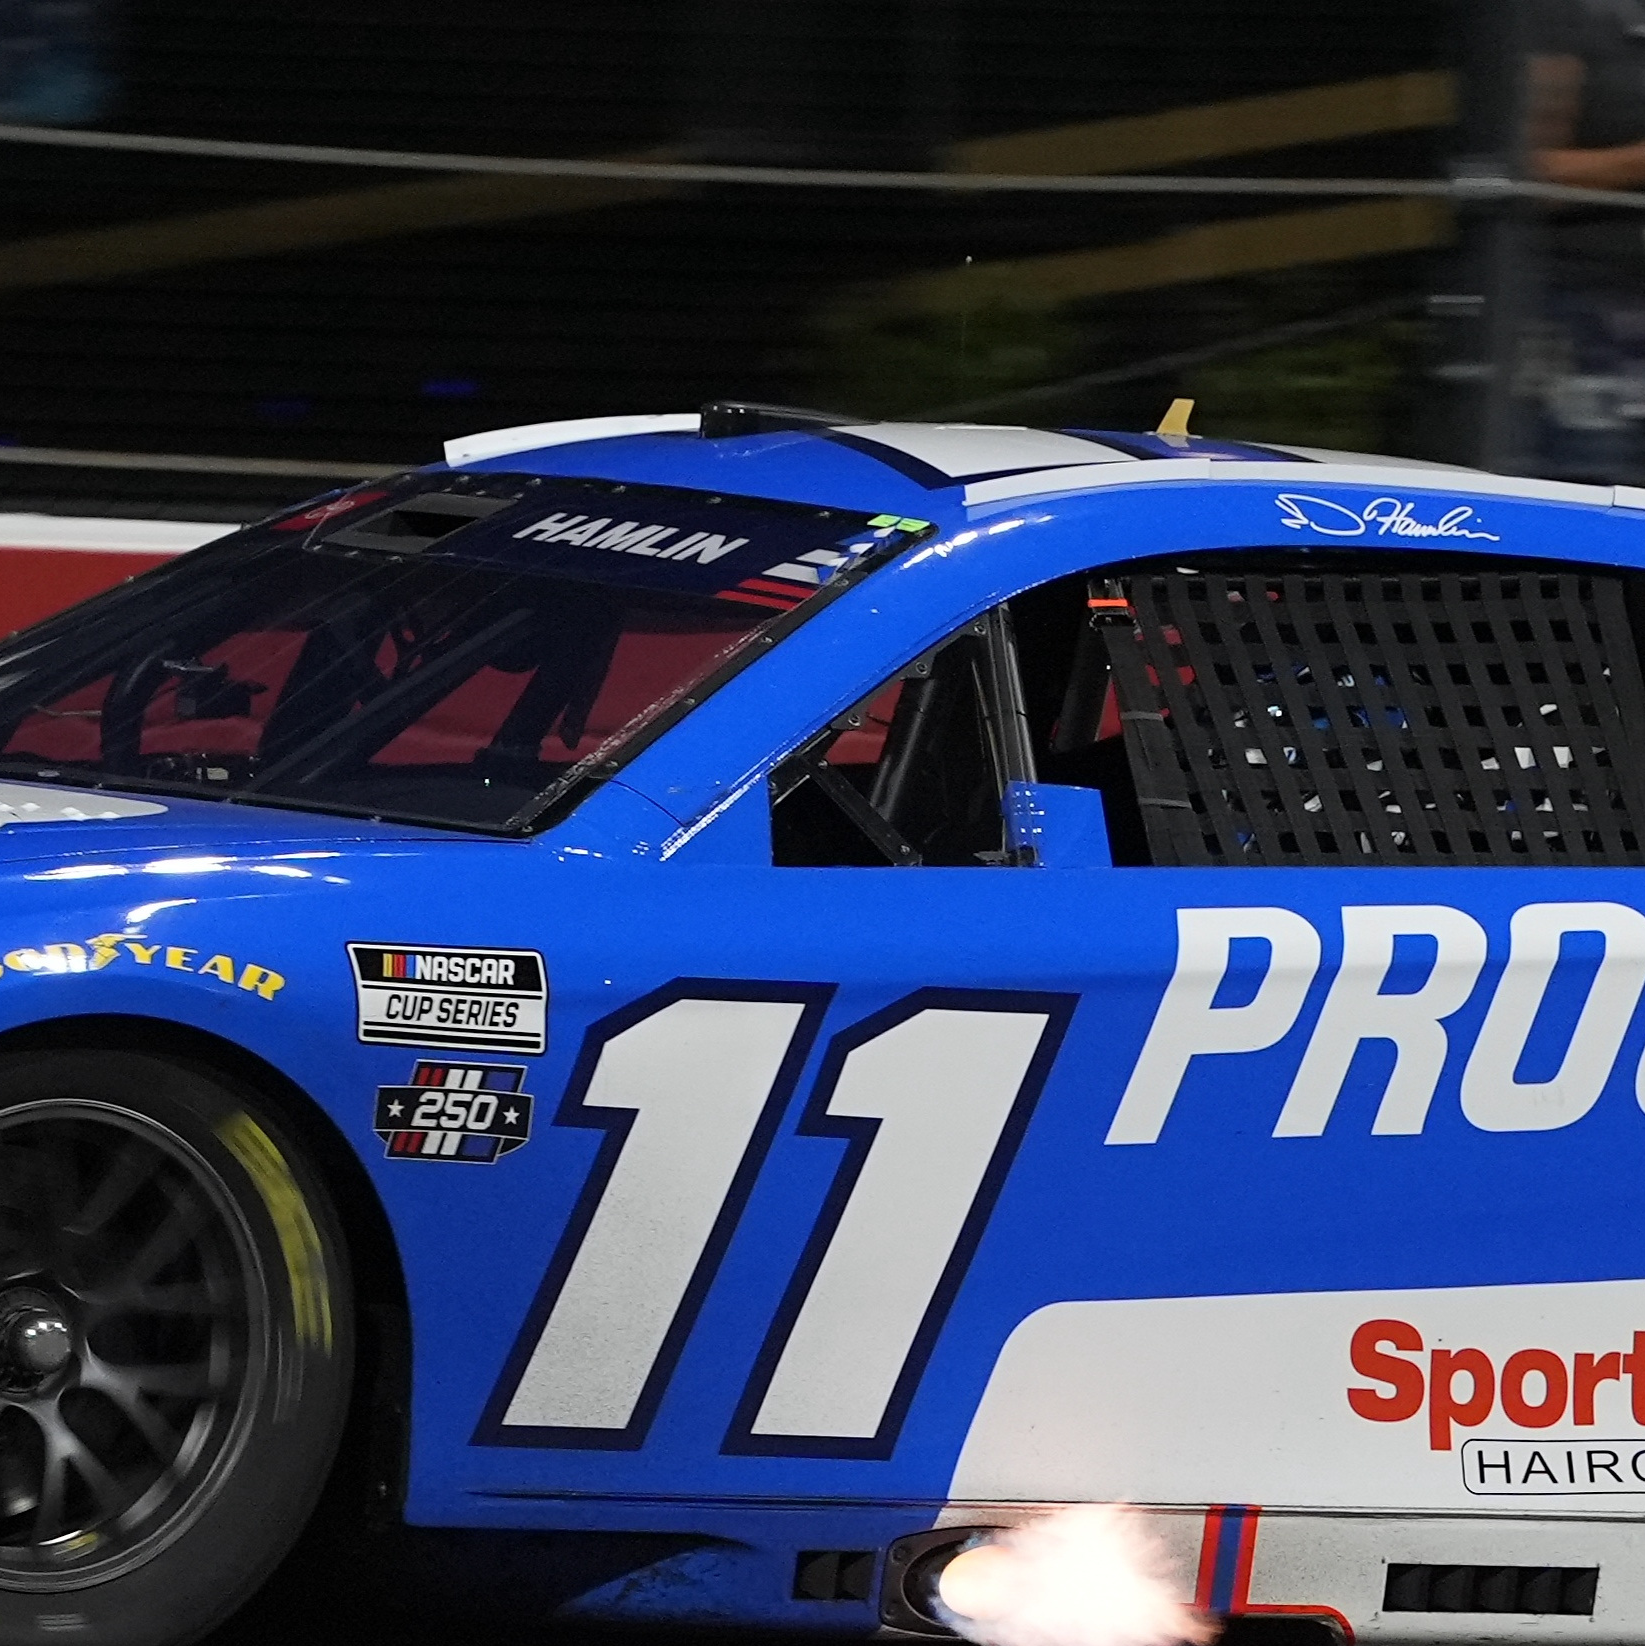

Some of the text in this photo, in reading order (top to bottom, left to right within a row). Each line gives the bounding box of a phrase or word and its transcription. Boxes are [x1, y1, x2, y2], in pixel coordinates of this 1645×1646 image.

[512, 511, 749, 565] HAMLIN
[414, 953, 516, 987] NASCAR
[386, 994, 519, 1028] CUP SERIES
[409, 1090, 497, 1131] 250
[468, 976, 1082, 1461] 11
